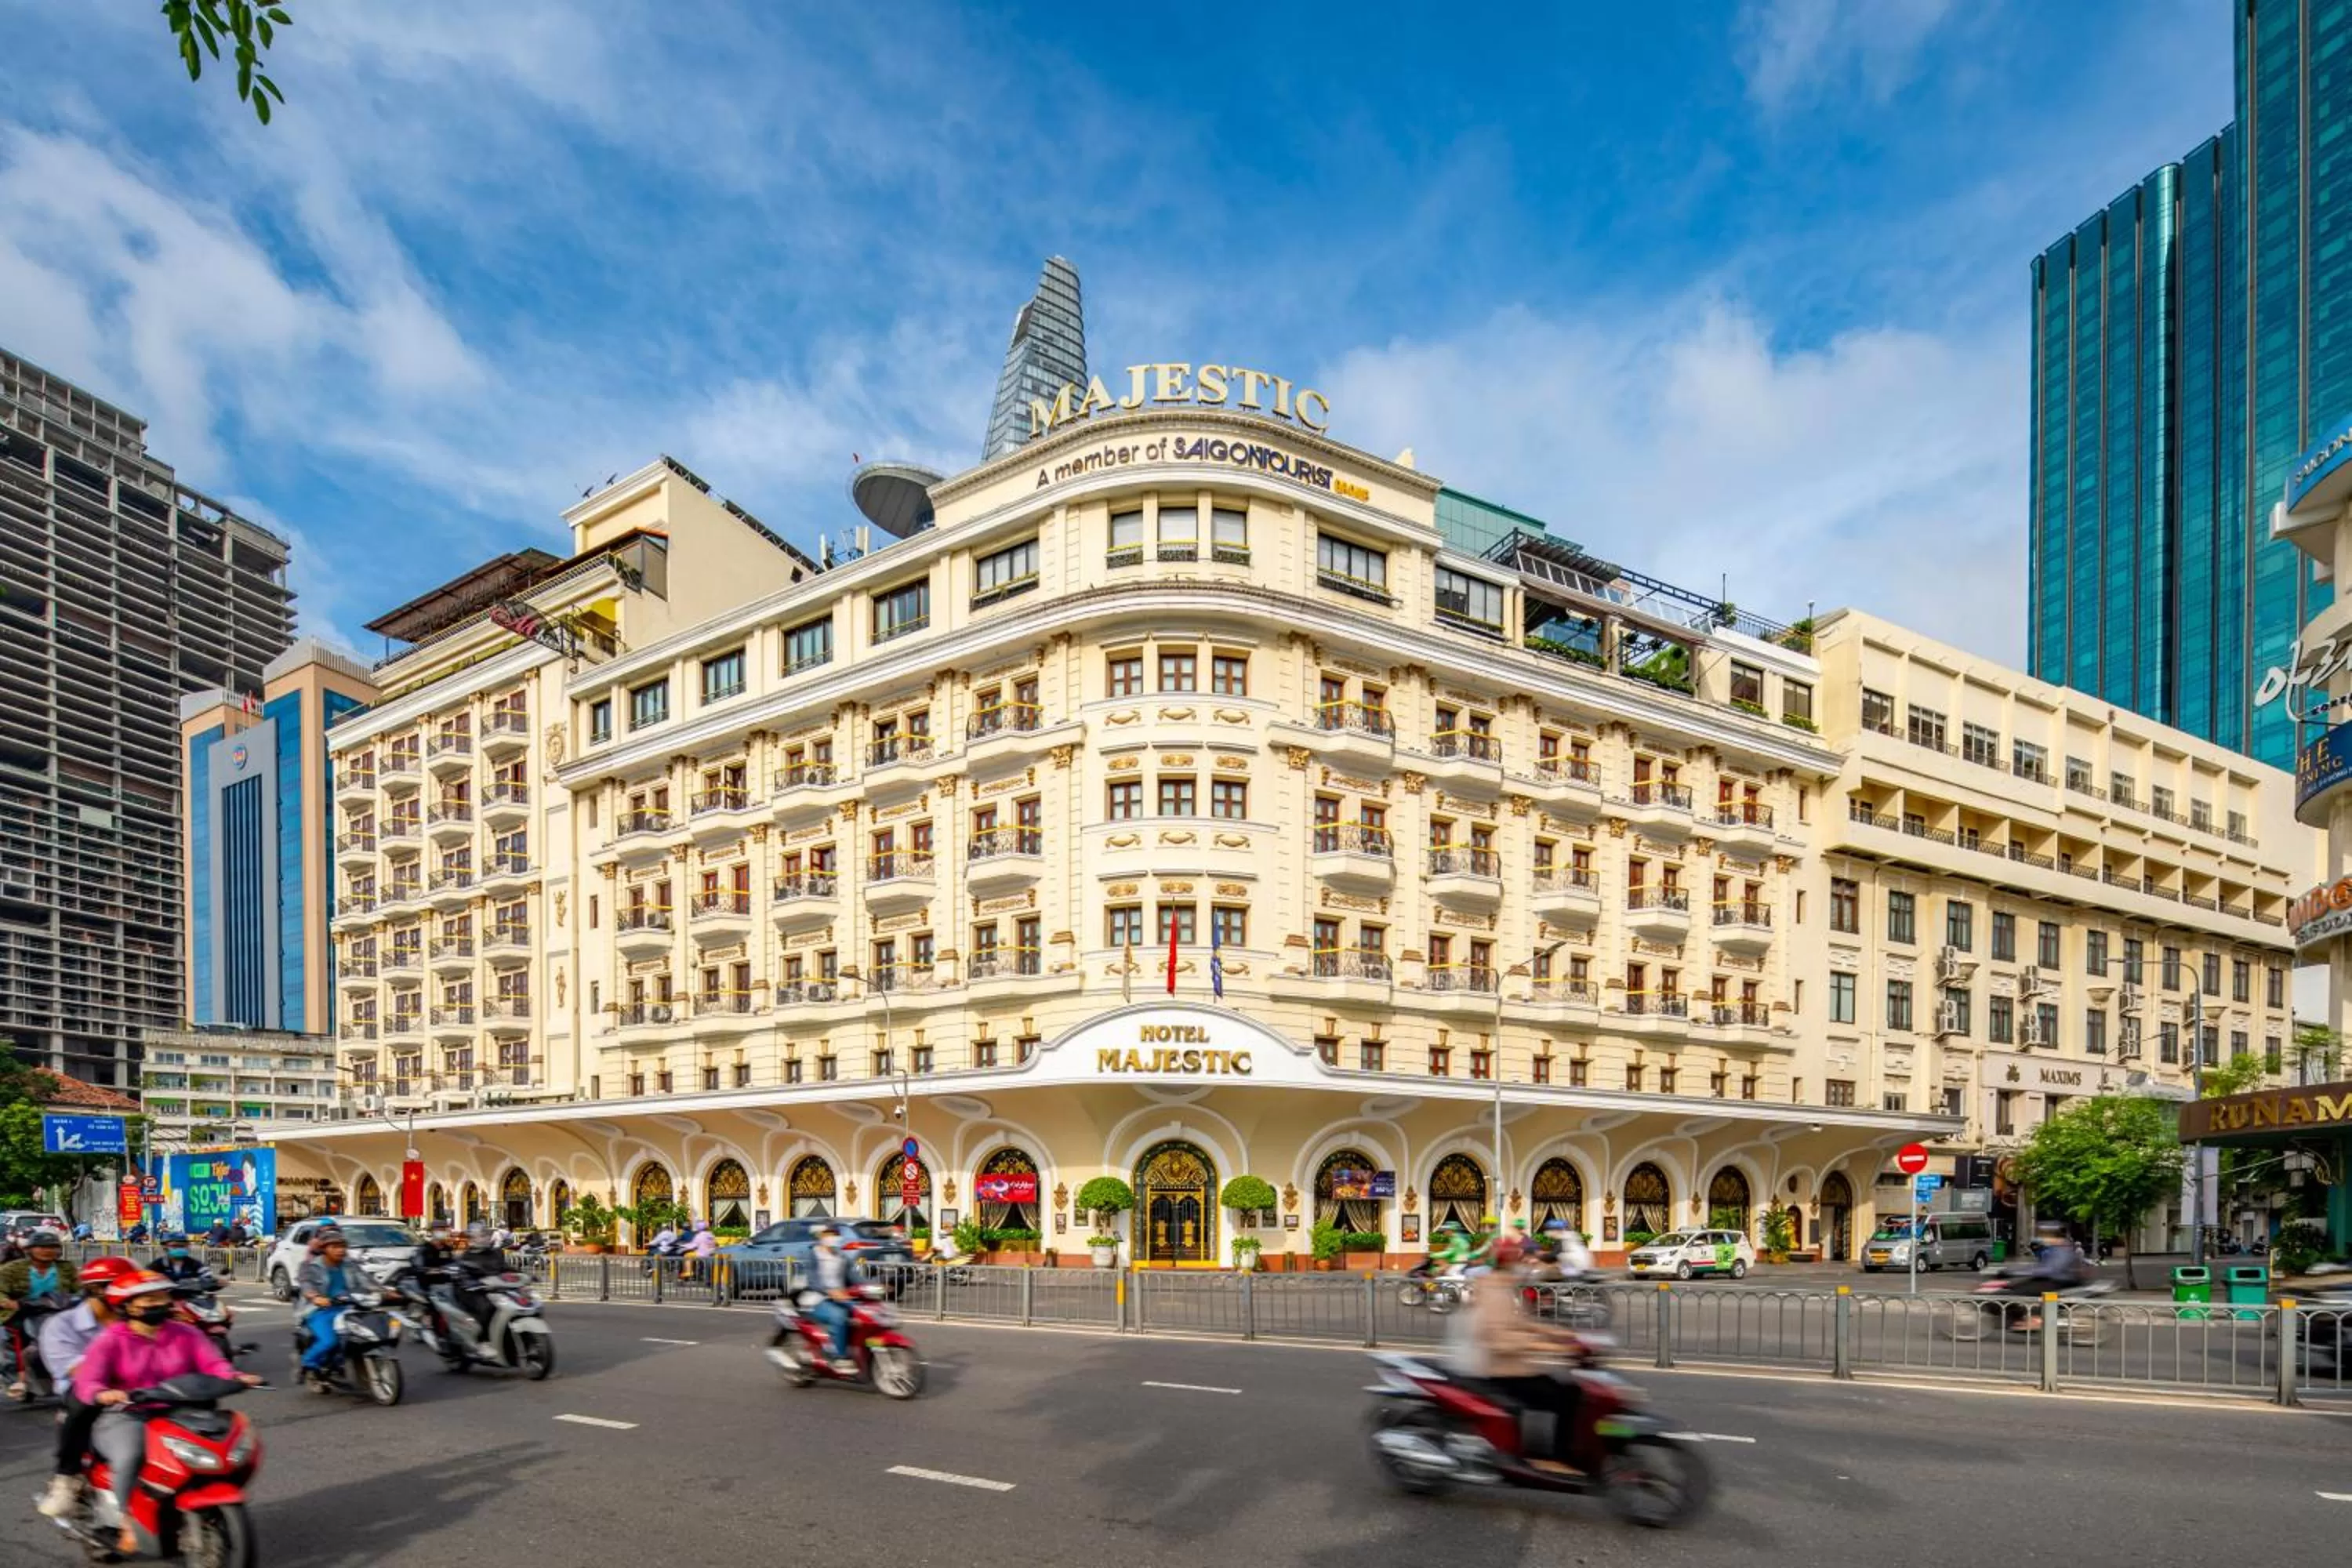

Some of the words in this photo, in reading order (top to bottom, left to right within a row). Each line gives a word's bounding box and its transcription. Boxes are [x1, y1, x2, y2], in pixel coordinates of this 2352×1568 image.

[1029, 363, 1330, 439] MAJESTIC
[1036, 469, 1050, 489] A
[1054, 445, 1140, 481] member
[1145, 437, 1167, 461] of
[1173, 437, 1333, 490] SAIGONTOURIST
[1140, 1025, 1210, 1044] HOTEL
[1098, 1049, 1253, 1075] MAJESTIC
[189, 1183, 231, 1214] SOJU
